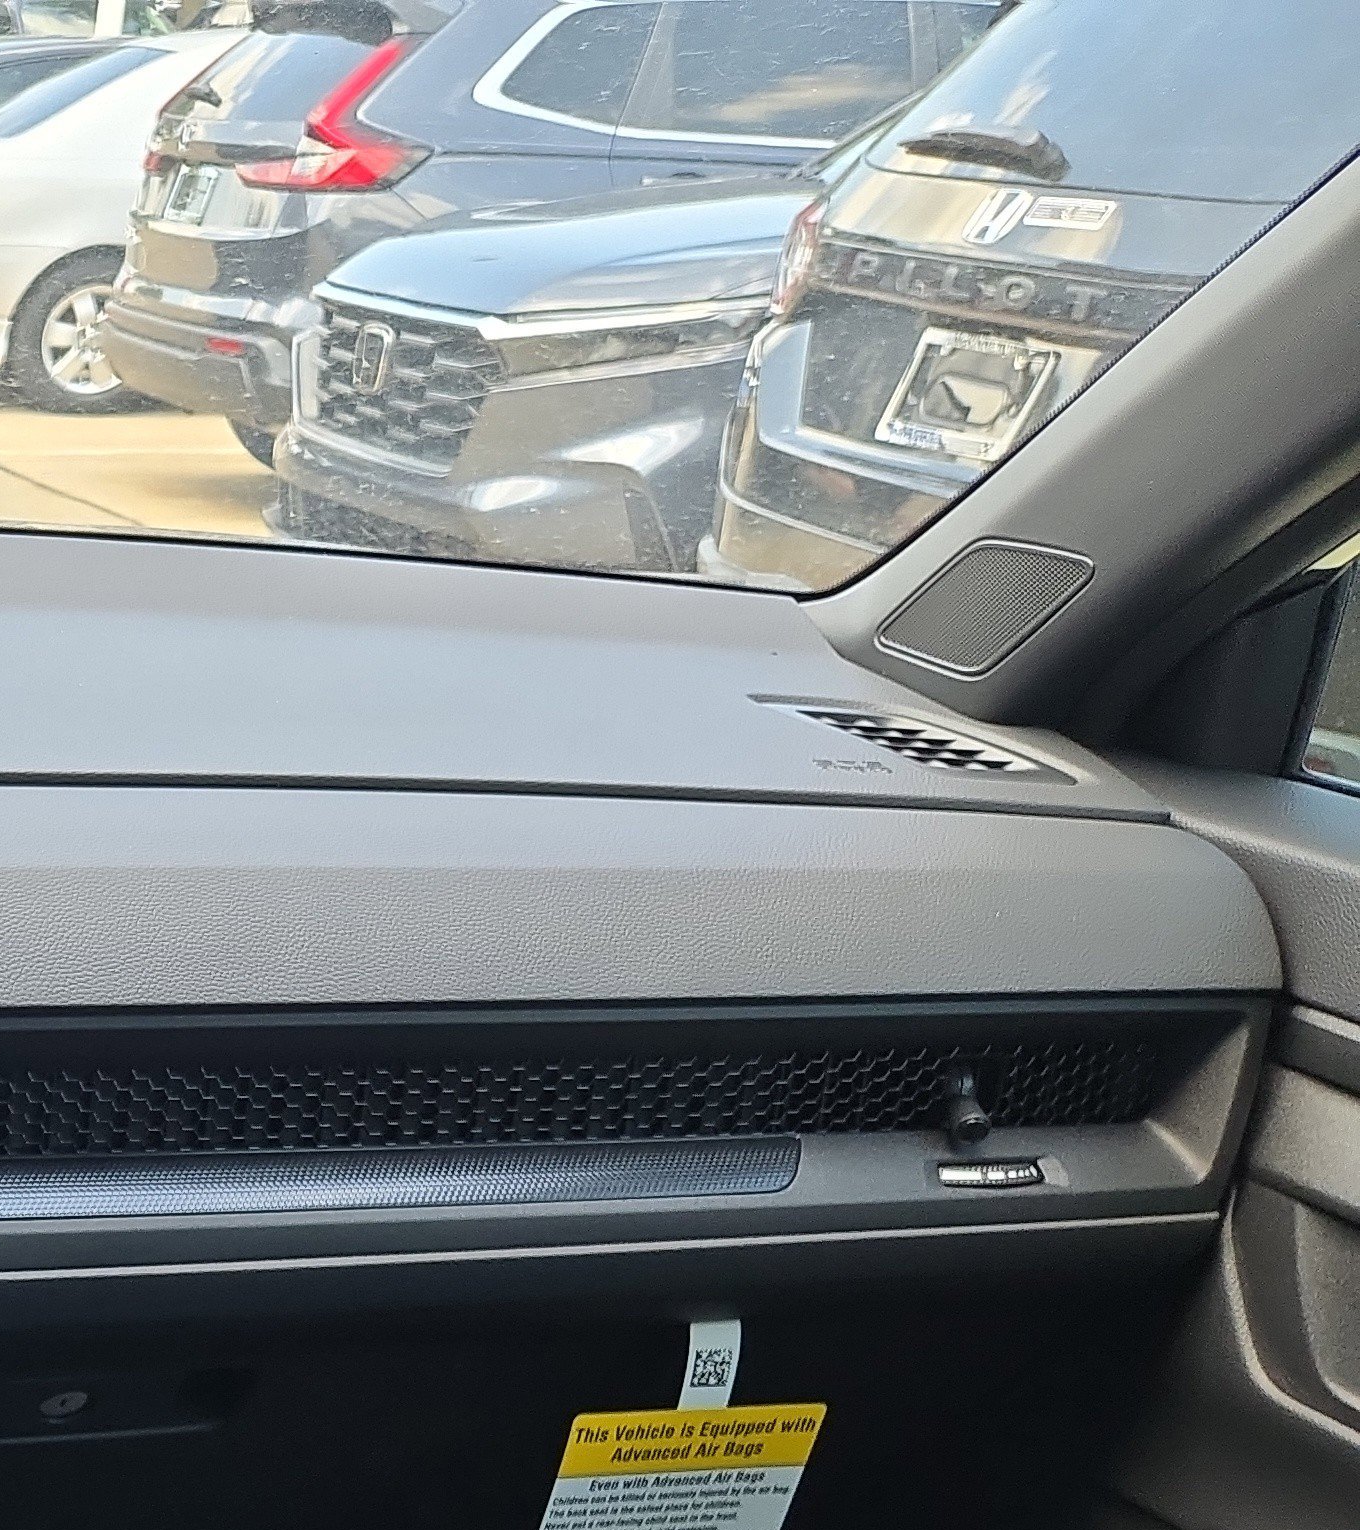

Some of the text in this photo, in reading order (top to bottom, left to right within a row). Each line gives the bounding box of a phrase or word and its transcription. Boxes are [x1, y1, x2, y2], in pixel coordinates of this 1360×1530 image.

[574, 1426, 609, 1444] This
[615, 1423, 675, 1442] Vehicle
[698, 1417, 777, 1440] Equipped
[779, 1416, 817, 1434] with
[610, 1440, 765, 1464] Advanced Air Bags
[588, 1471, 766, 1492] Even with Advanced Air Bags
[552, 1496, 588, 1506] Children
